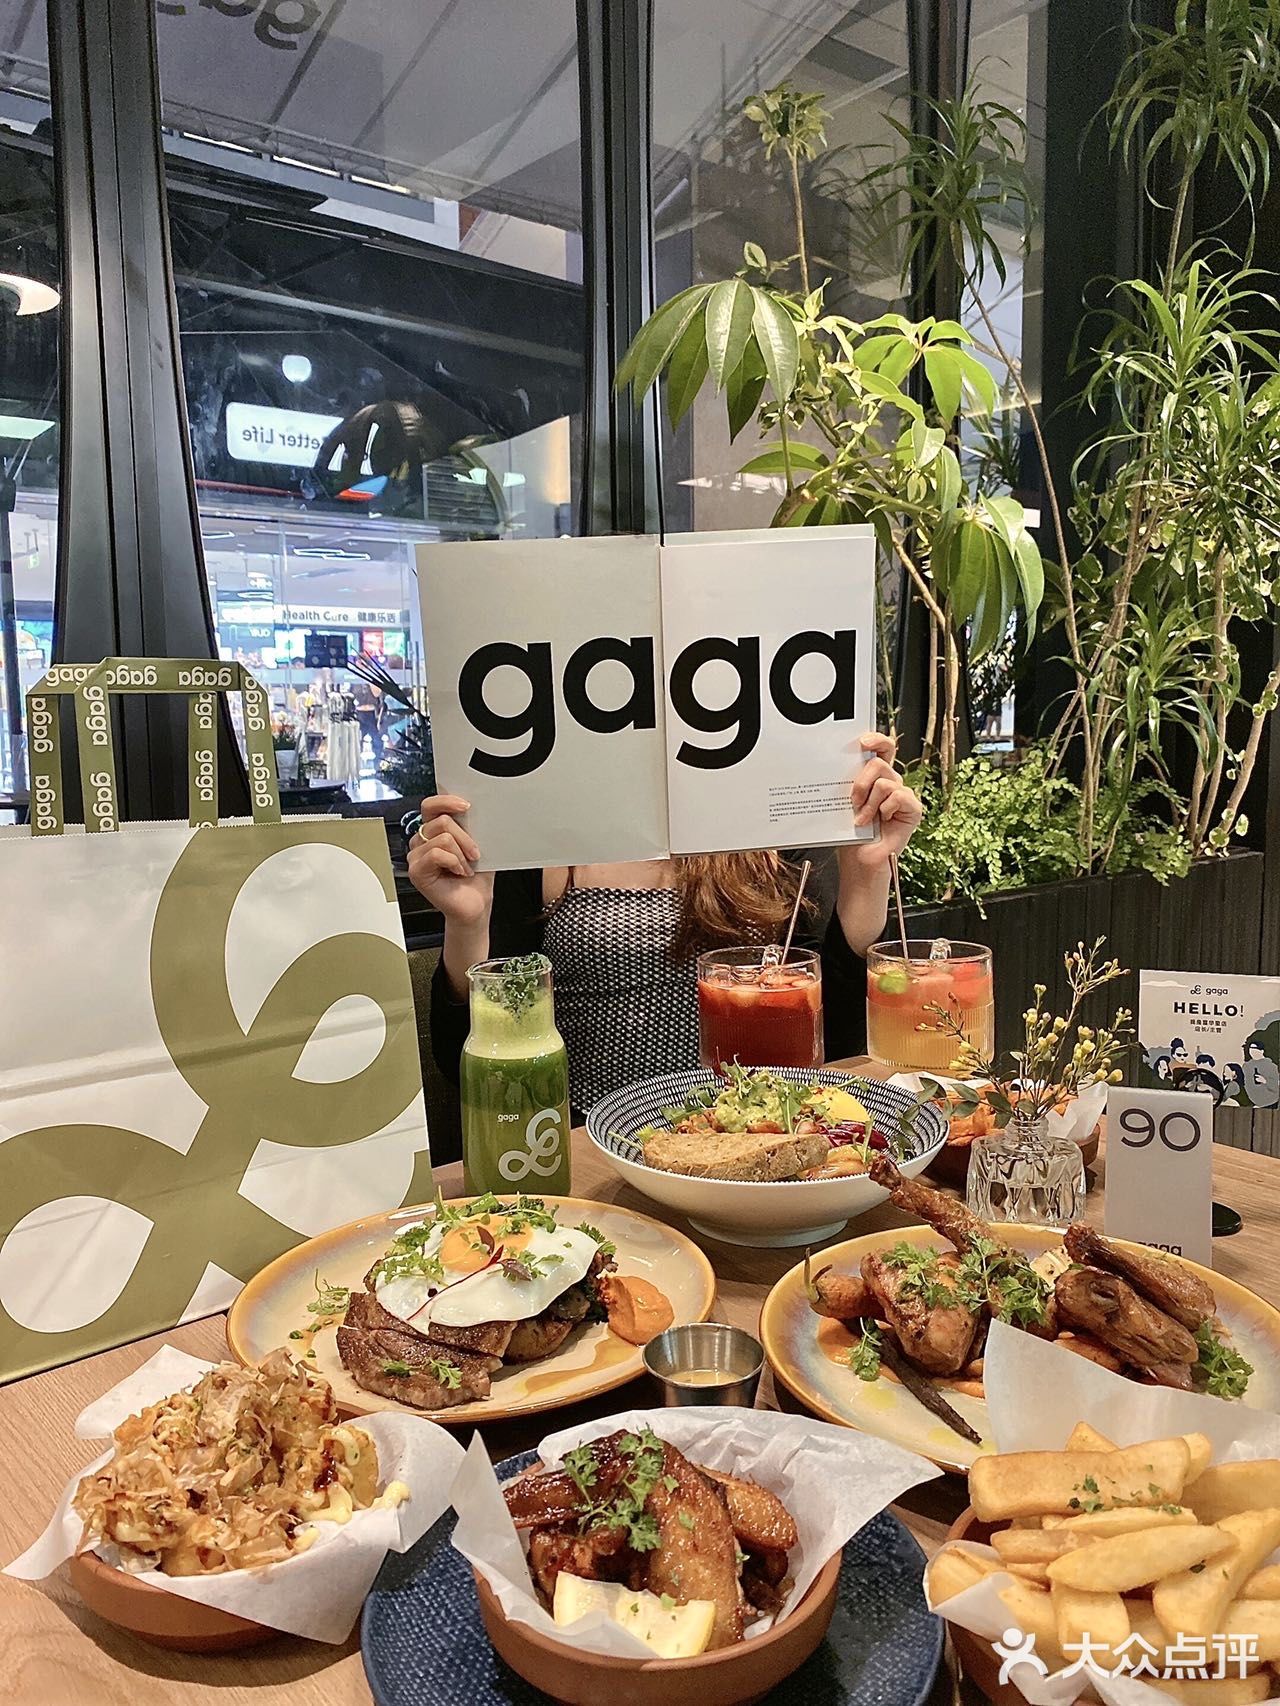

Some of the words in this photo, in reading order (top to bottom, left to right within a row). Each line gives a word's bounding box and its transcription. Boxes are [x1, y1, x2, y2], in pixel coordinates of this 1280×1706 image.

[283, 610, 320, 621] Health
[357, 611, 396, 623] 健康乐活
[178, 666, 232, 686] gaga
[31, 697, 53, 754] gaga
[83, 686, 108, 746] gaga
[244, 677, 265, 730] gaga
[458, 630, 856, 778] gaga
[90, 771, 114, 831] gaga
[195, 749, 213, 801] gaga
[252, 753, 273, 807] gaga
[35, 774, 57, 830] gaga
[1174, 1002, 1244, 1017] HELLO!
[1206, 988, 1228, 996] gaga
[498, 1114, 519, 1123] gaga
[1120, 1108, 1201, 1152] 90
